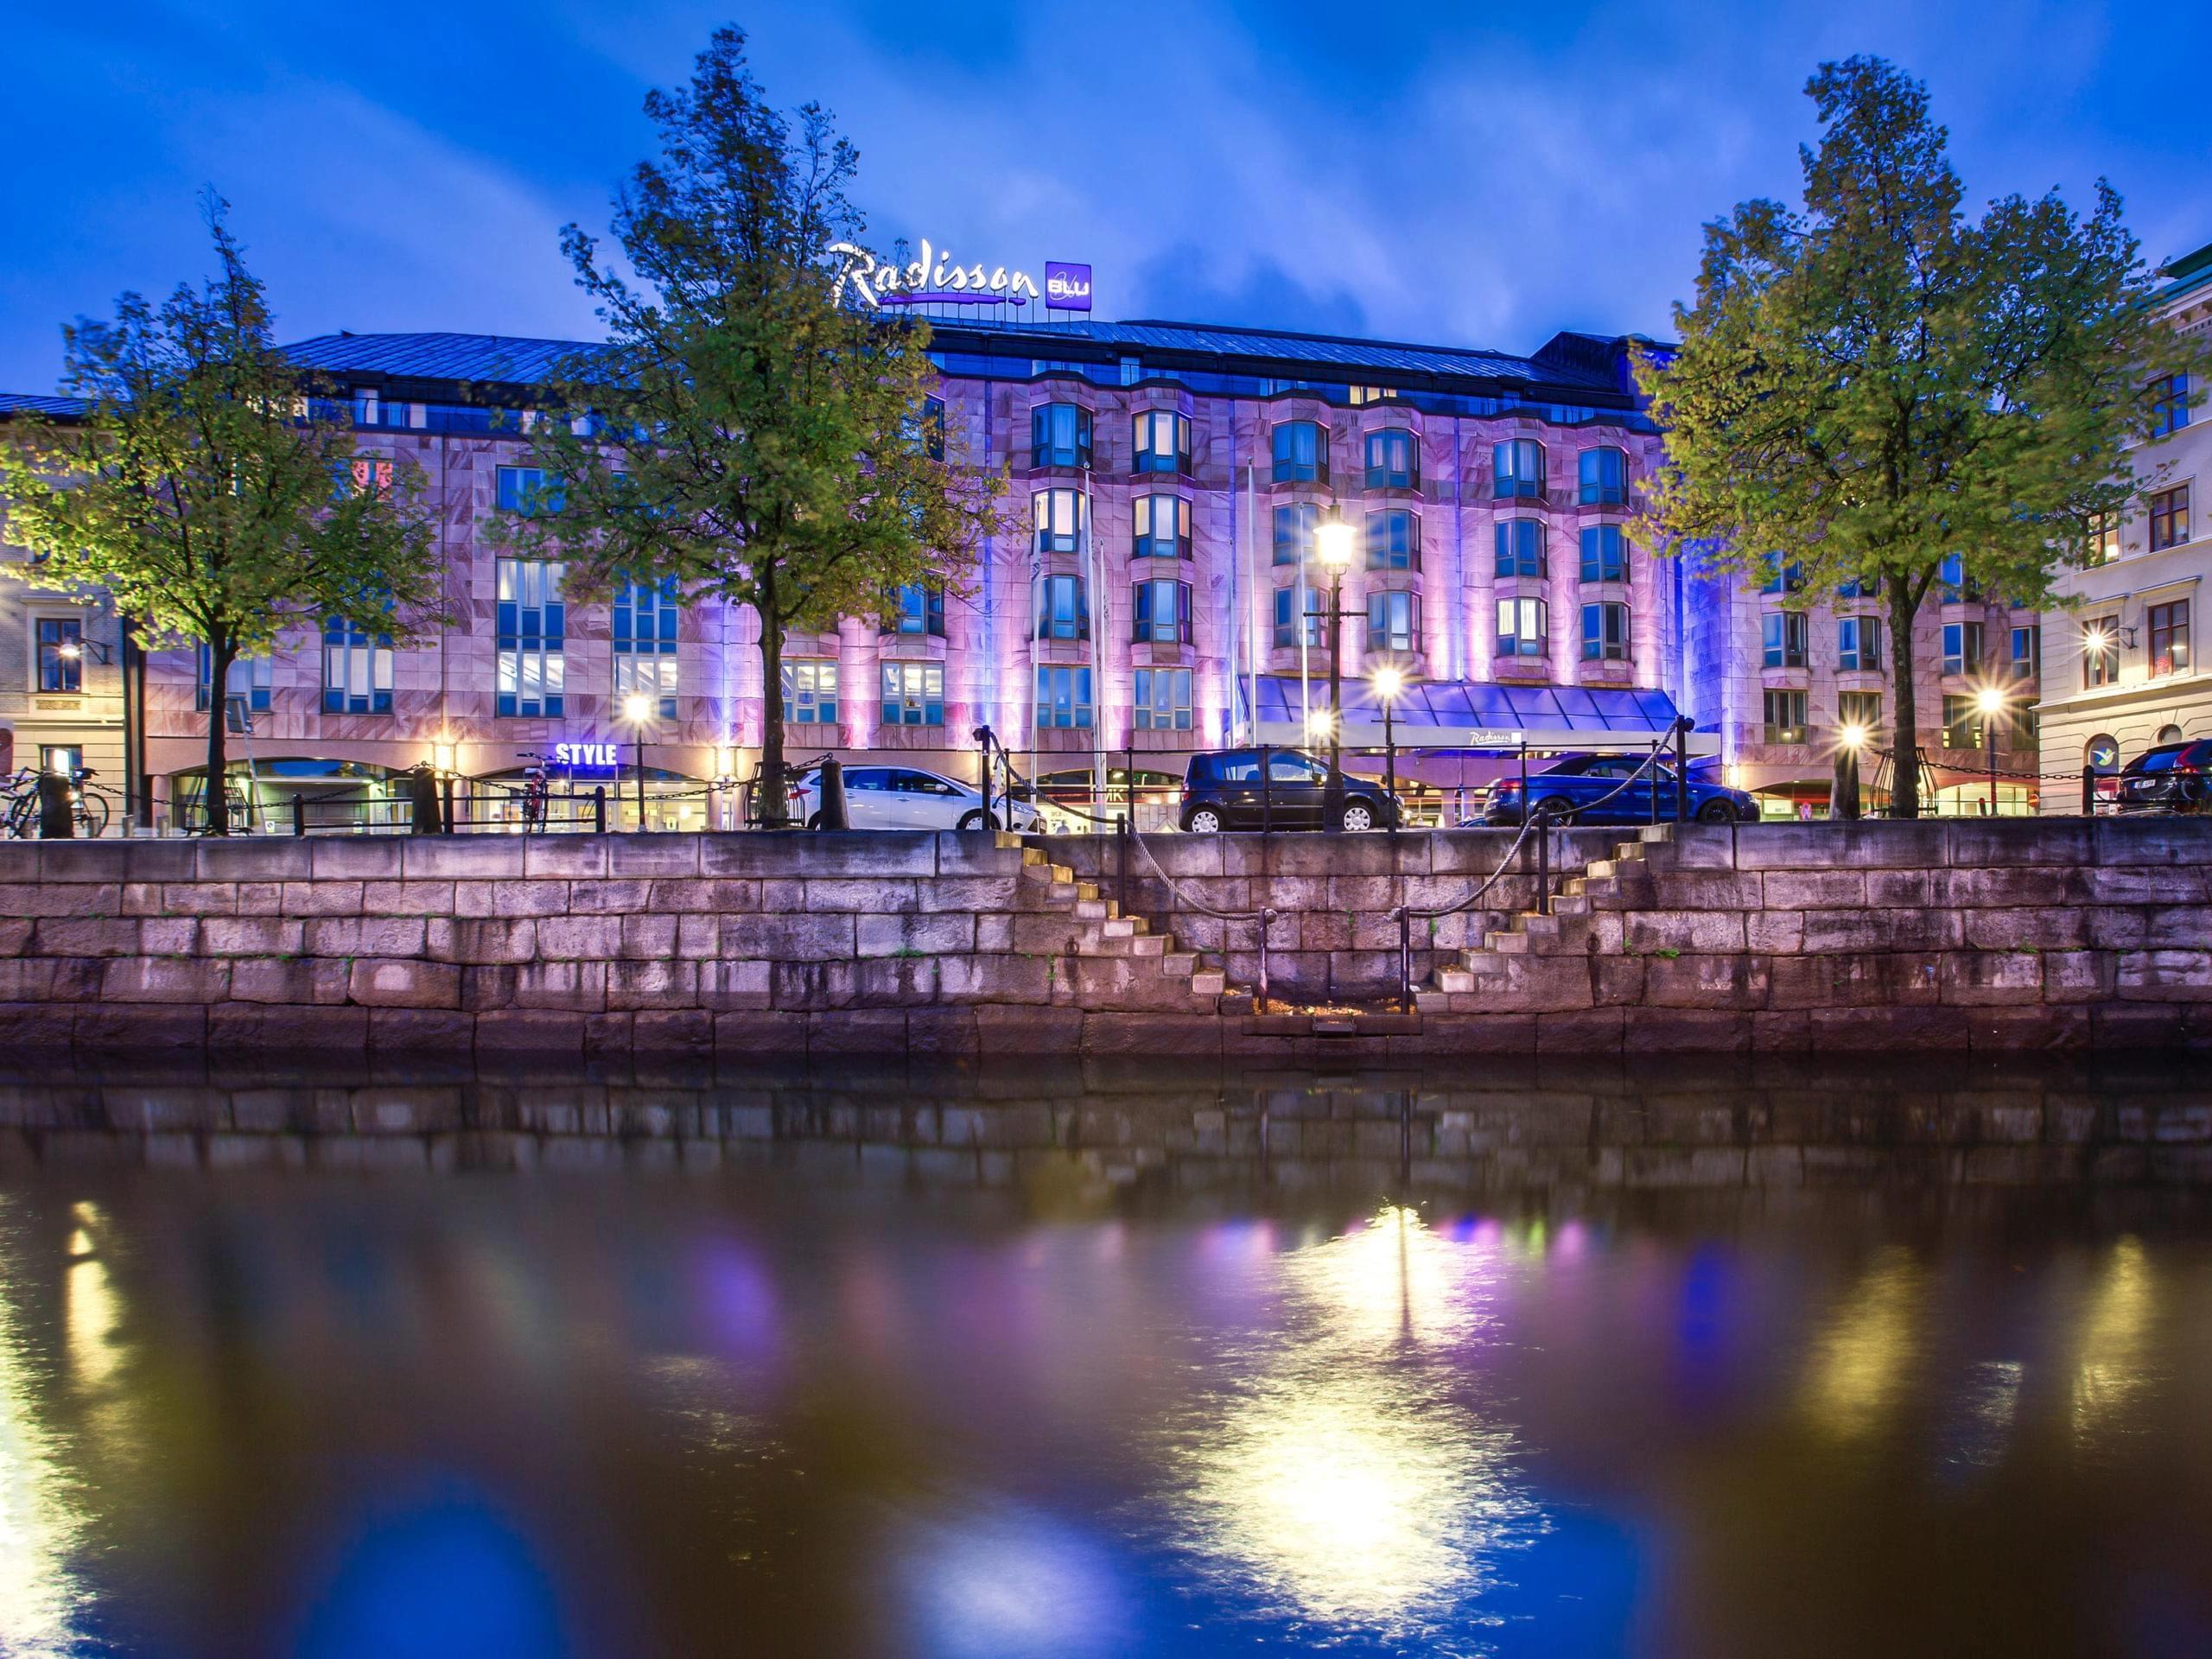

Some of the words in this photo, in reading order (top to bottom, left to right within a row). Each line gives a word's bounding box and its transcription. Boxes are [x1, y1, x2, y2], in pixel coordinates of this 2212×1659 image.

[829, 238, 1039, 309] Radisson
[1048, 278, 1090, 297] BLU
[1470, 730, 1510, 746] Radisson
[556, 743, 617, 765] STYLE
